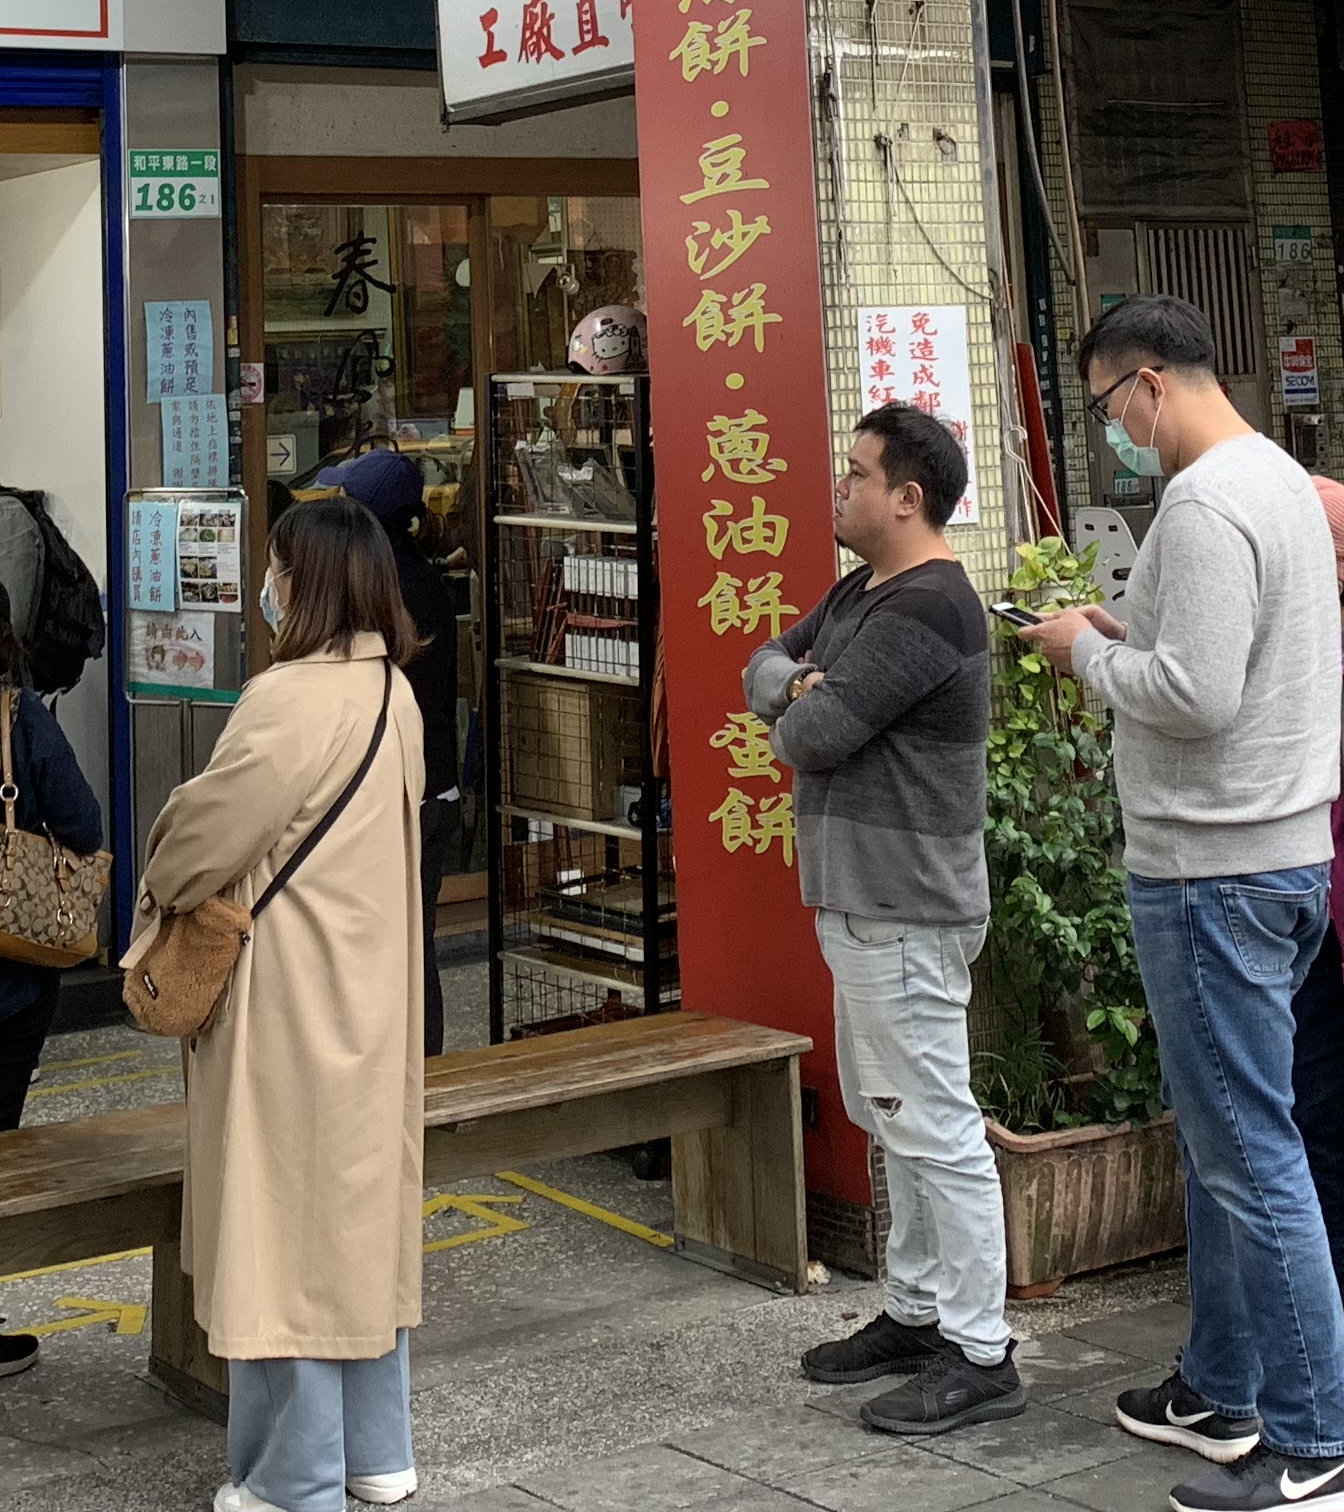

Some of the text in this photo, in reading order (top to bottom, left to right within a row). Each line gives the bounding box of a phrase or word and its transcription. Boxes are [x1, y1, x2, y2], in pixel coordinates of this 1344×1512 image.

[133, 154, 217, 172] 和平東路一段
[135, 182, 196, 212] 186
[1277, 241, 1311, 260] 186
[1285, 375, 1315, 387] SECOM
